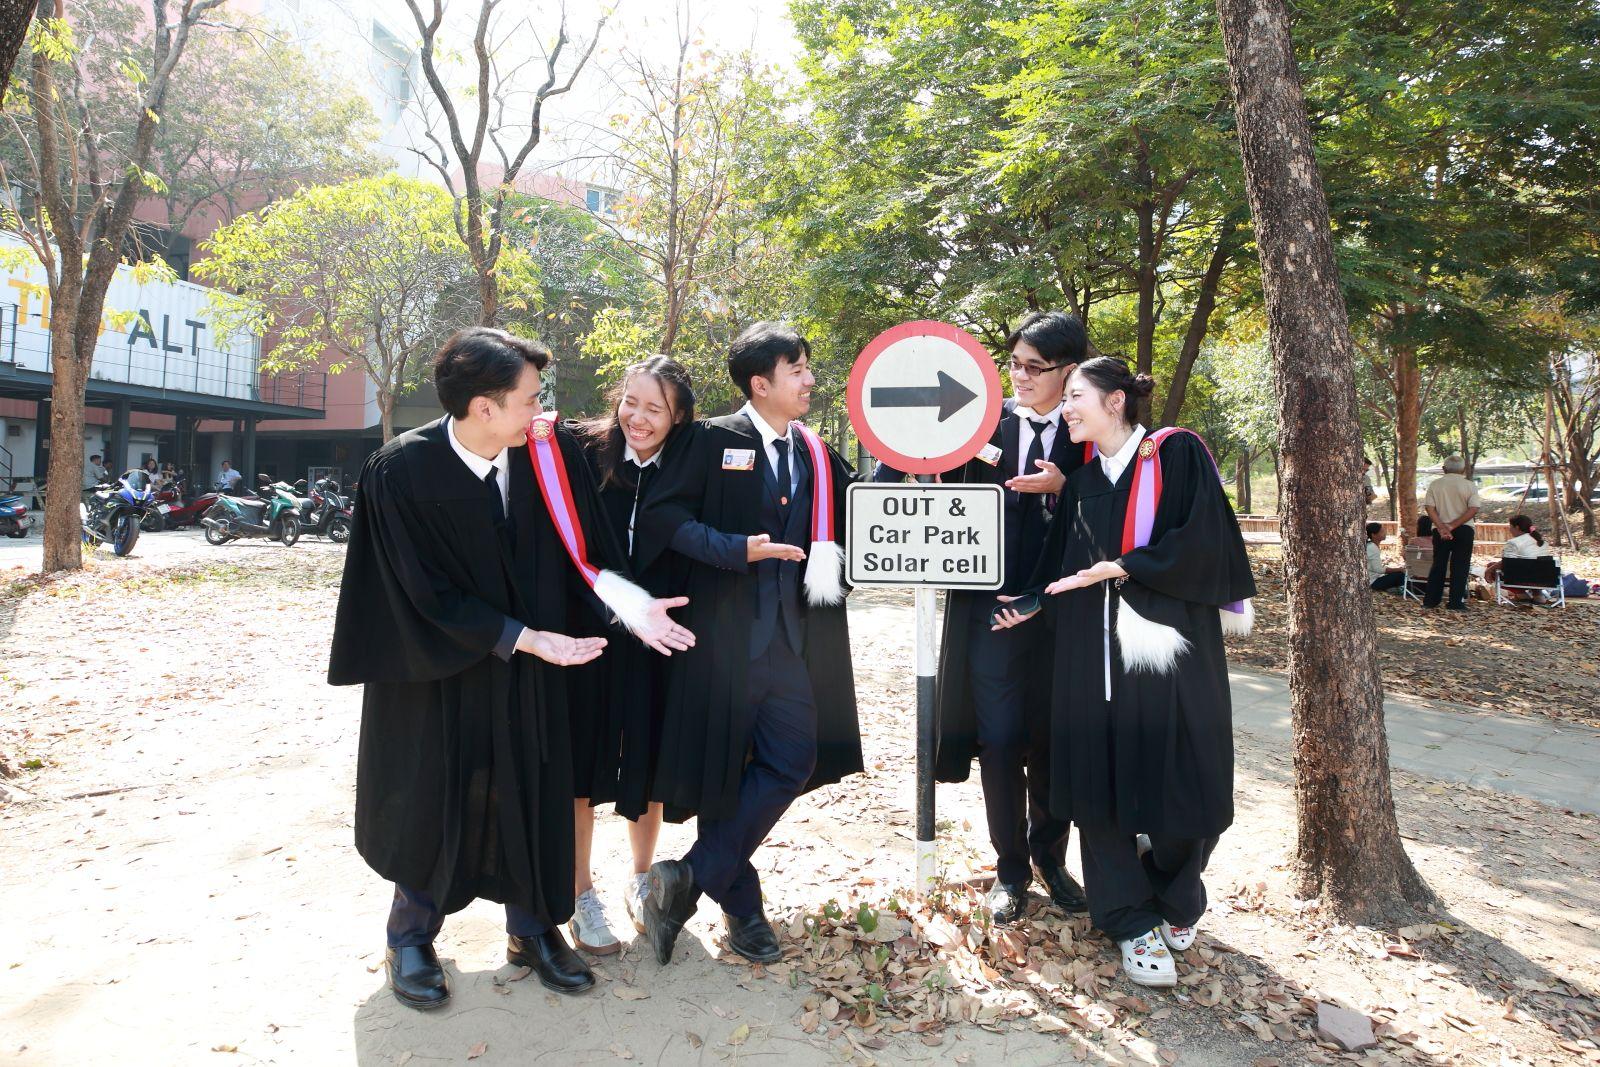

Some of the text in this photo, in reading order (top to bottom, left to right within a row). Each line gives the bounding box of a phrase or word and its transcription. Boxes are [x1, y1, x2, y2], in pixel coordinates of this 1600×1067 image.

[127, 308, 206, 356] ALT
[883, 496, 966, 517] OUT &
[869, 525, 981, 545] Car Park
[863, 552, 987, 574] Solar cell
